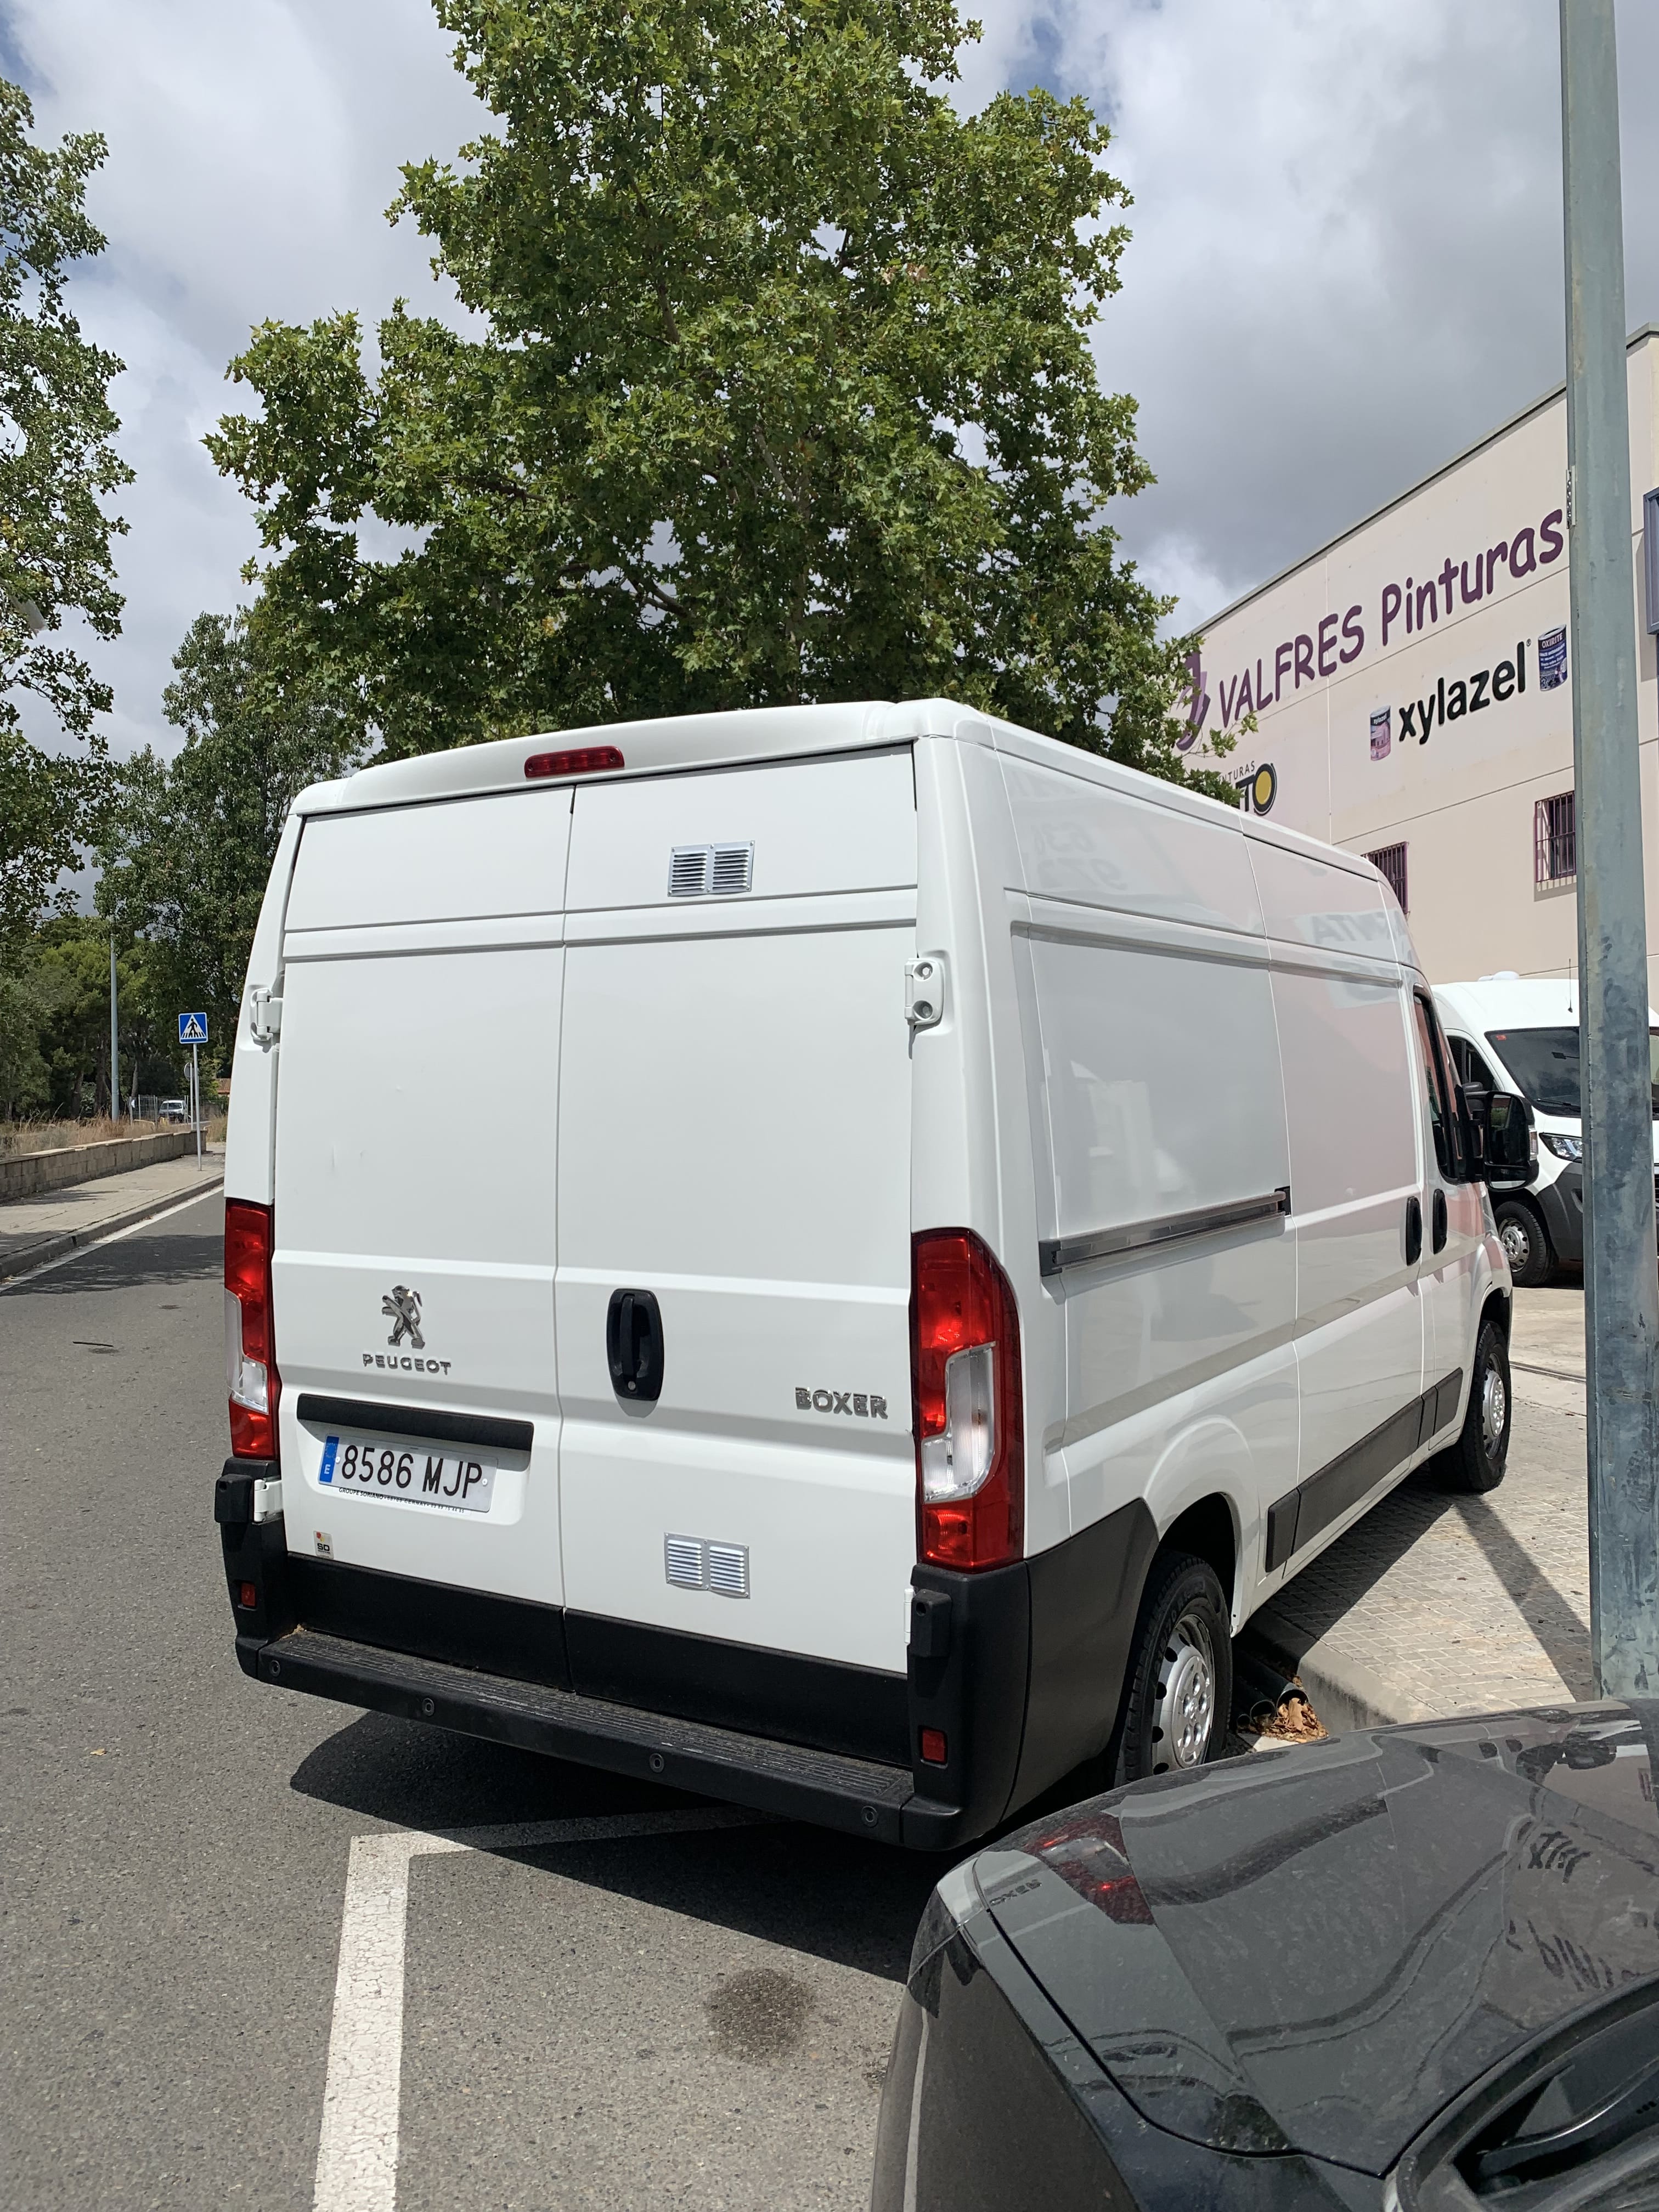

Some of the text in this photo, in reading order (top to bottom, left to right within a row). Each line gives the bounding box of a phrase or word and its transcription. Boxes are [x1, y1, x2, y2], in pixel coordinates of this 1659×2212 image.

[1220, 509, 1564, 727] VALFRES Pinturas
[1542, 632, 1564, 648] OXIRITE
[1398, 641, 1526, 745] xylazel
[363, 1353, 452, 1375] PEUGEOT
[795, 1387, 888, 1419] BOXER
[323, 1464, 331, 1475] E
[341, 1444, 483, 1499] 8586 MJP
[338, 1487, 359, 1496] GROUPE
[360, 1491, 383, 1500] SORIANO
[317, 1543, 330, 1551] SD
